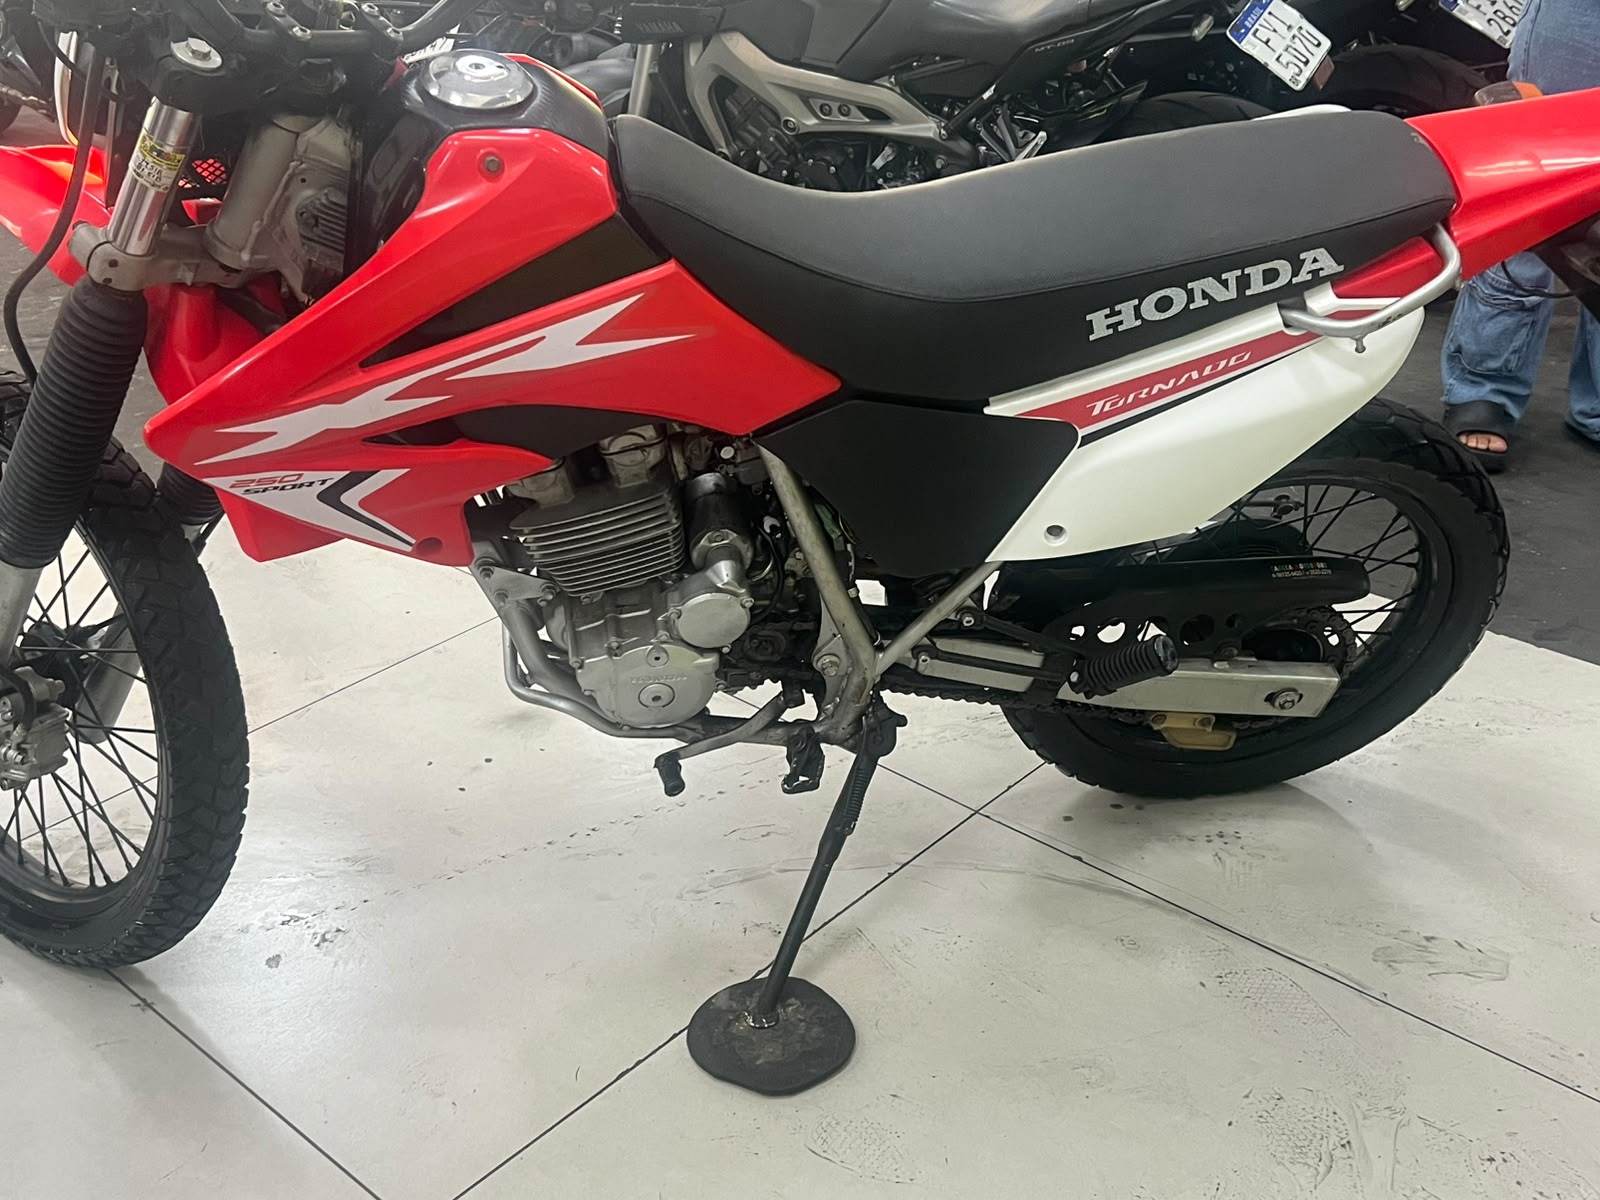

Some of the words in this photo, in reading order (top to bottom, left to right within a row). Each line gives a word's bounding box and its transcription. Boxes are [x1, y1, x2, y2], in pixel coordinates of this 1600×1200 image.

[1244, 6, 1264, 29] BRASIL
[1251, 10, 1294, 53] FYI
[1275, 25, 1322, 78] 5D70
[1085, 247, 1345, 341] HONDA
[1086, 350, 1252, 416] TORNADO
[229, 473, 304, 488] 250
[242, 477, 334, 495] SPORT
